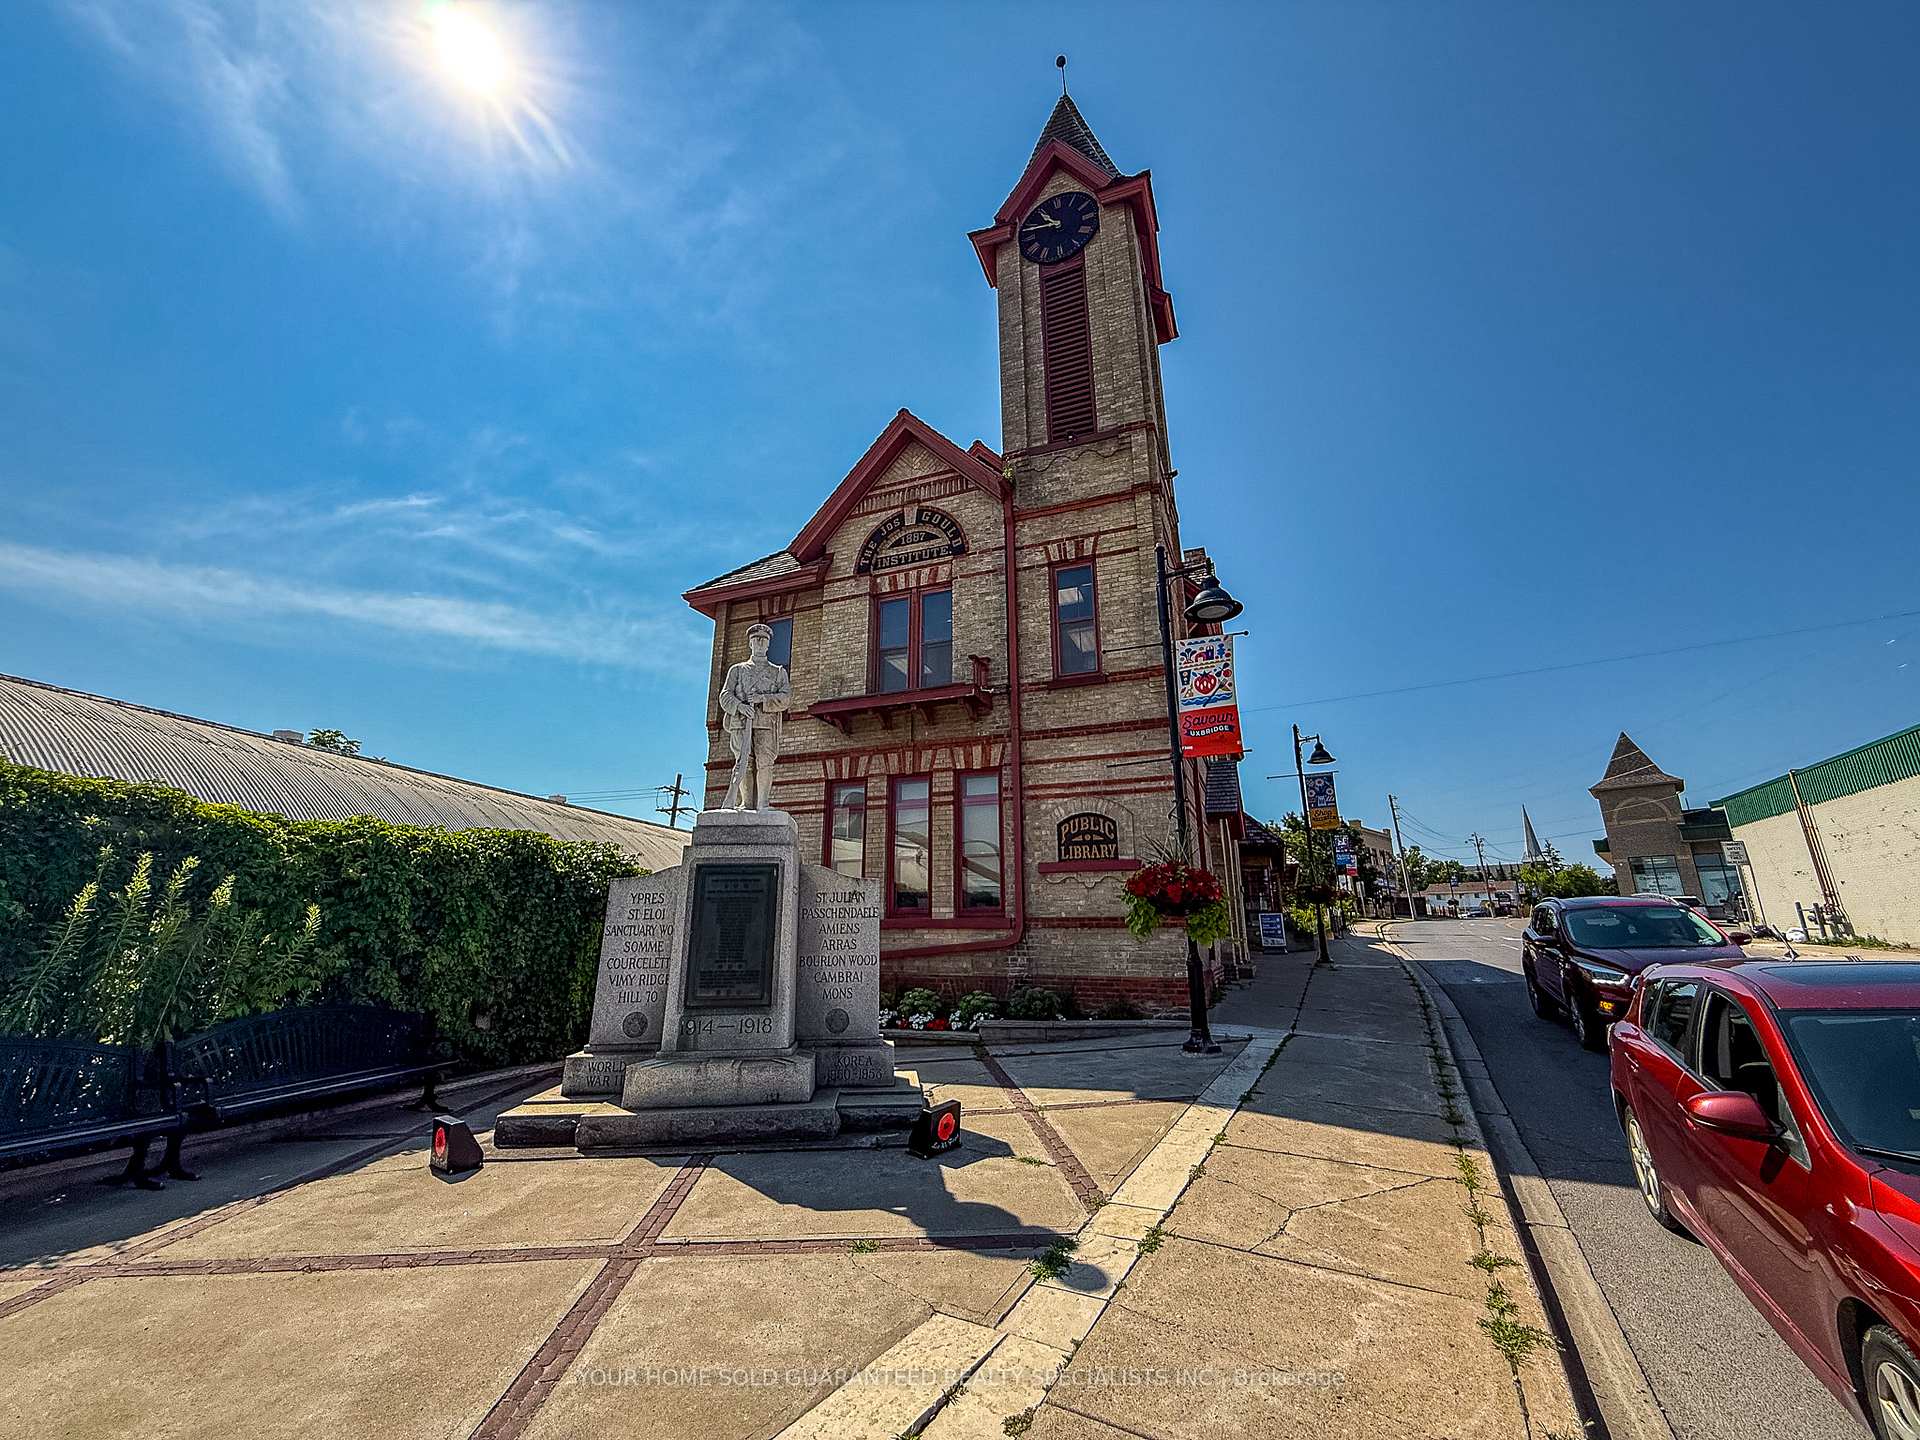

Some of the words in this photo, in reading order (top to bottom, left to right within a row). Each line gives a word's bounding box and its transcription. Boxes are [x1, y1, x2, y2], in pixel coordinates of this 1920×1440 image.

[860, 540, 877, 566] THE
[881, 518, 901, 536] JOS
[921, 511, 962, 547] GOULD
[901, 532, 926, 545] 1887
[1182, 712, 1235, 730] Savour
[1189, 725, 1230, 737] UXBRIDGE
[1061, 816, 1115, 844] PUBLIC
[1060, 844, 1117, 860] LIBRARY
[630, 892, 665, 904] YPRES
[643, 908, 666, 920] ELOI
[801, 906, 880, 919] PASSCHENDAELE
[604, 924, 658, 937] SANCTUARY
[819, 923, 860, 935] AMIENS
[623, 940, 665, 953] SOMME
[821, 939, 857, 951] ARRAS
[800, 955, 846, 968] BOURLON
[848, 954, 878, 967] WOOD
[609, 974, 636, 986] VIMY
[814, 970, 863, 983] CAMBRAI
[618, 991, 641, 1004] HILL
[645, 991, 658, 1003] 70
[822, 987, 853, 1000] MONS
[588, 1061, 626, 1073] WORLD
[836, 1055, 873, 1068] KOREA
[586, 1075, 610, 1088] WAR
